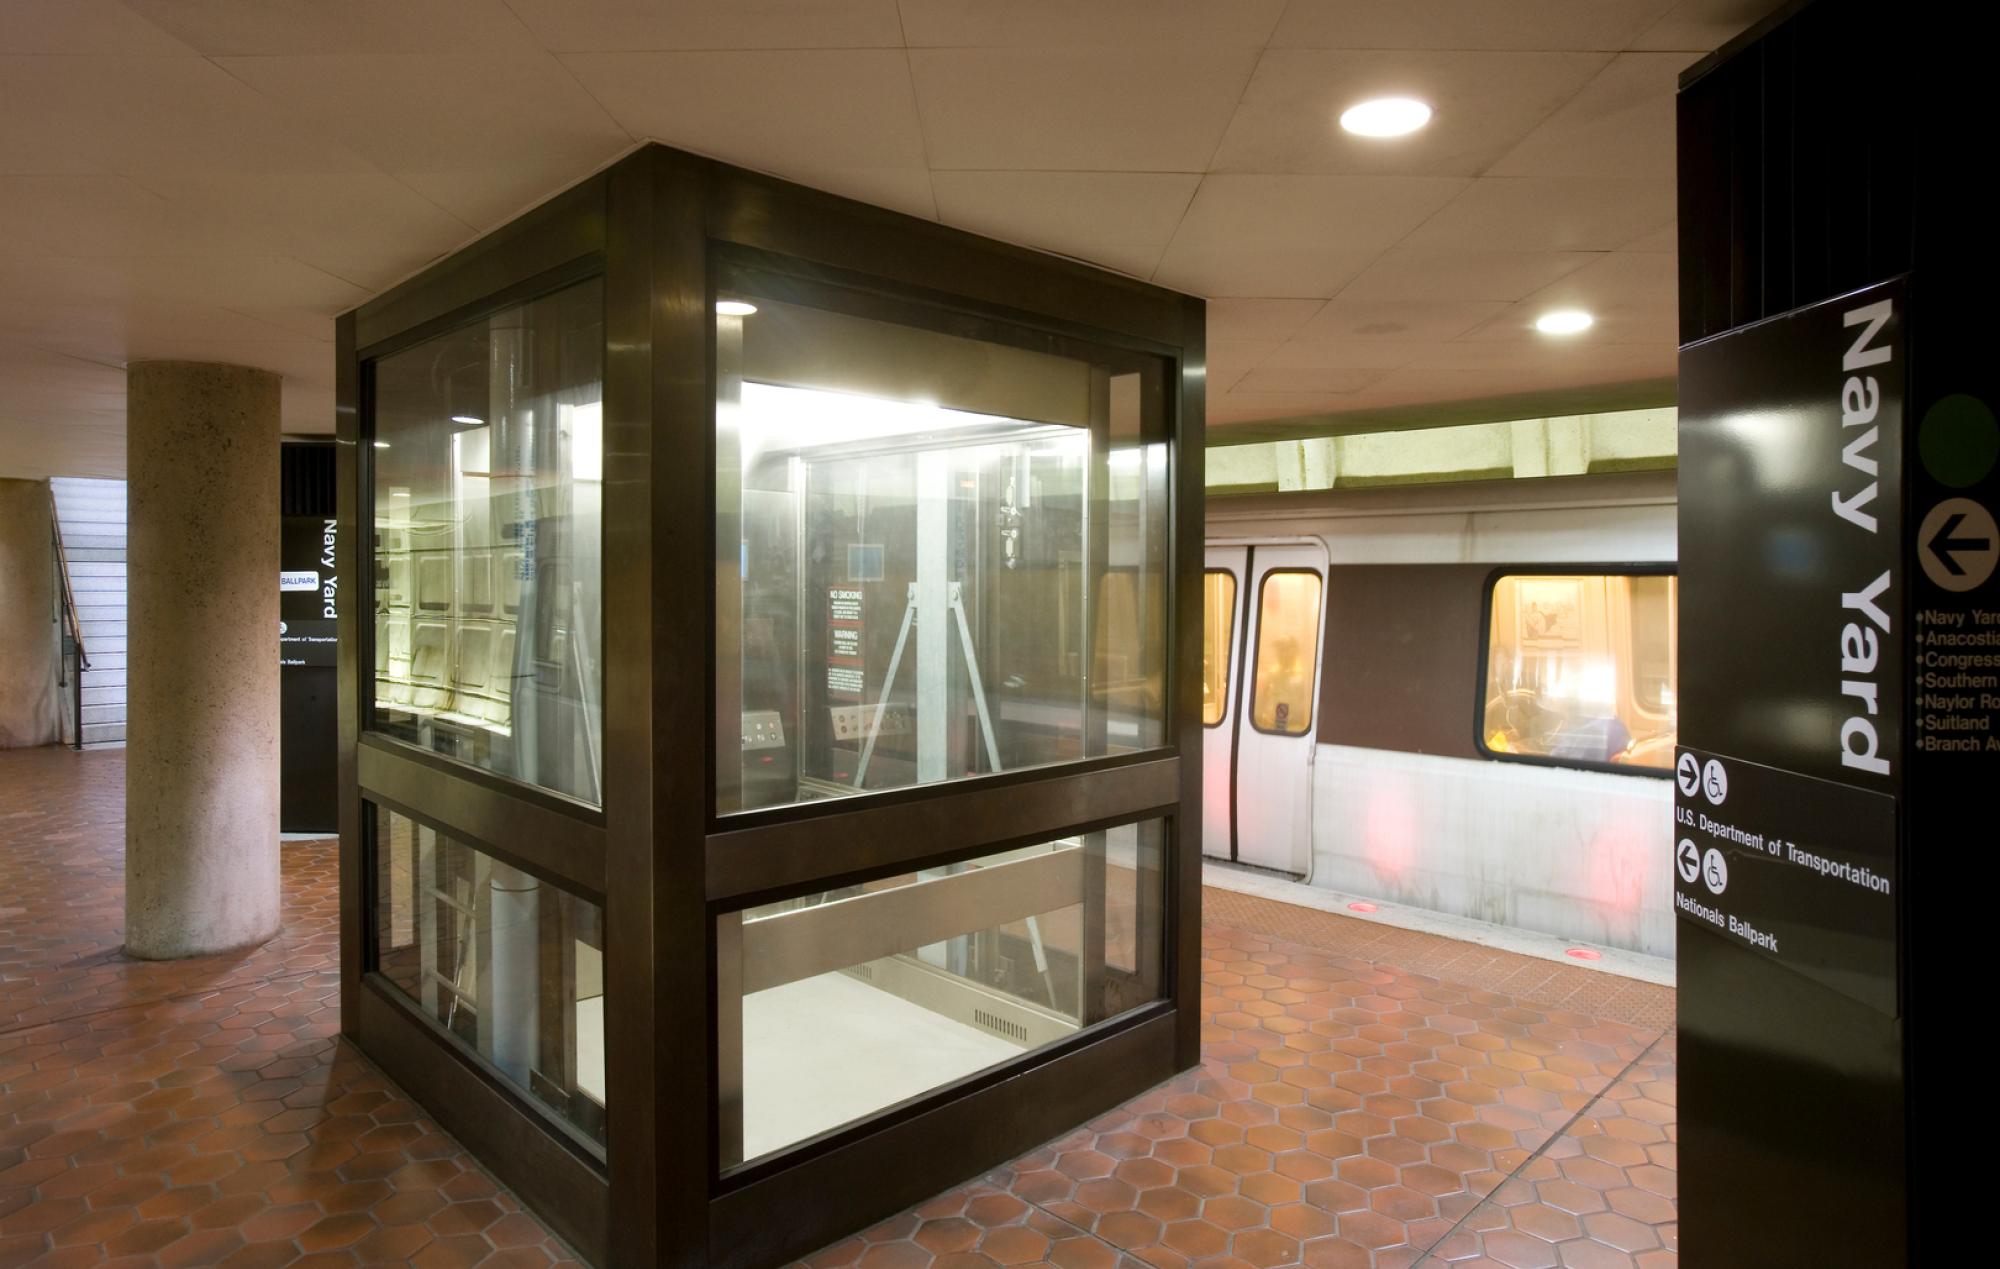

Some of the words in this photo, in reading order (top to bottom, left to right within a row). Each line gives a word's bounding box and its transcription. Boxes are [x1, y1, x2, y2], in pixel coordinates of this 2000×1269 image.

[1832, 299, 1893, 534] Navy
[321, 519, 338, 569] Navy
[281, 577, 316, 585] BALLPARK
[324, 576, 338, 619] Yard
[1925, 609, 1965, 628] Navy
[1925, 651, 2000, 670] Congress
[1841, 569, 1891, 776] Yard
[1925, 672, 1997, 688] Southern
[1925, 693, 1975, 712] Naylor
[1925, 714, 1989, 730] Suitland
[1925, 735, 1980, 751] Branch
[1676, 805, 1696, 827] U.S.
[1699, 813, 1764, 851] Department
[1768, 839, 1782, 857] of
[1785, 842, 1890, 895] Transportation
[1676, 891, 1725, 928] Nationals
[1729, 915, 1779, 953] Ballpark
